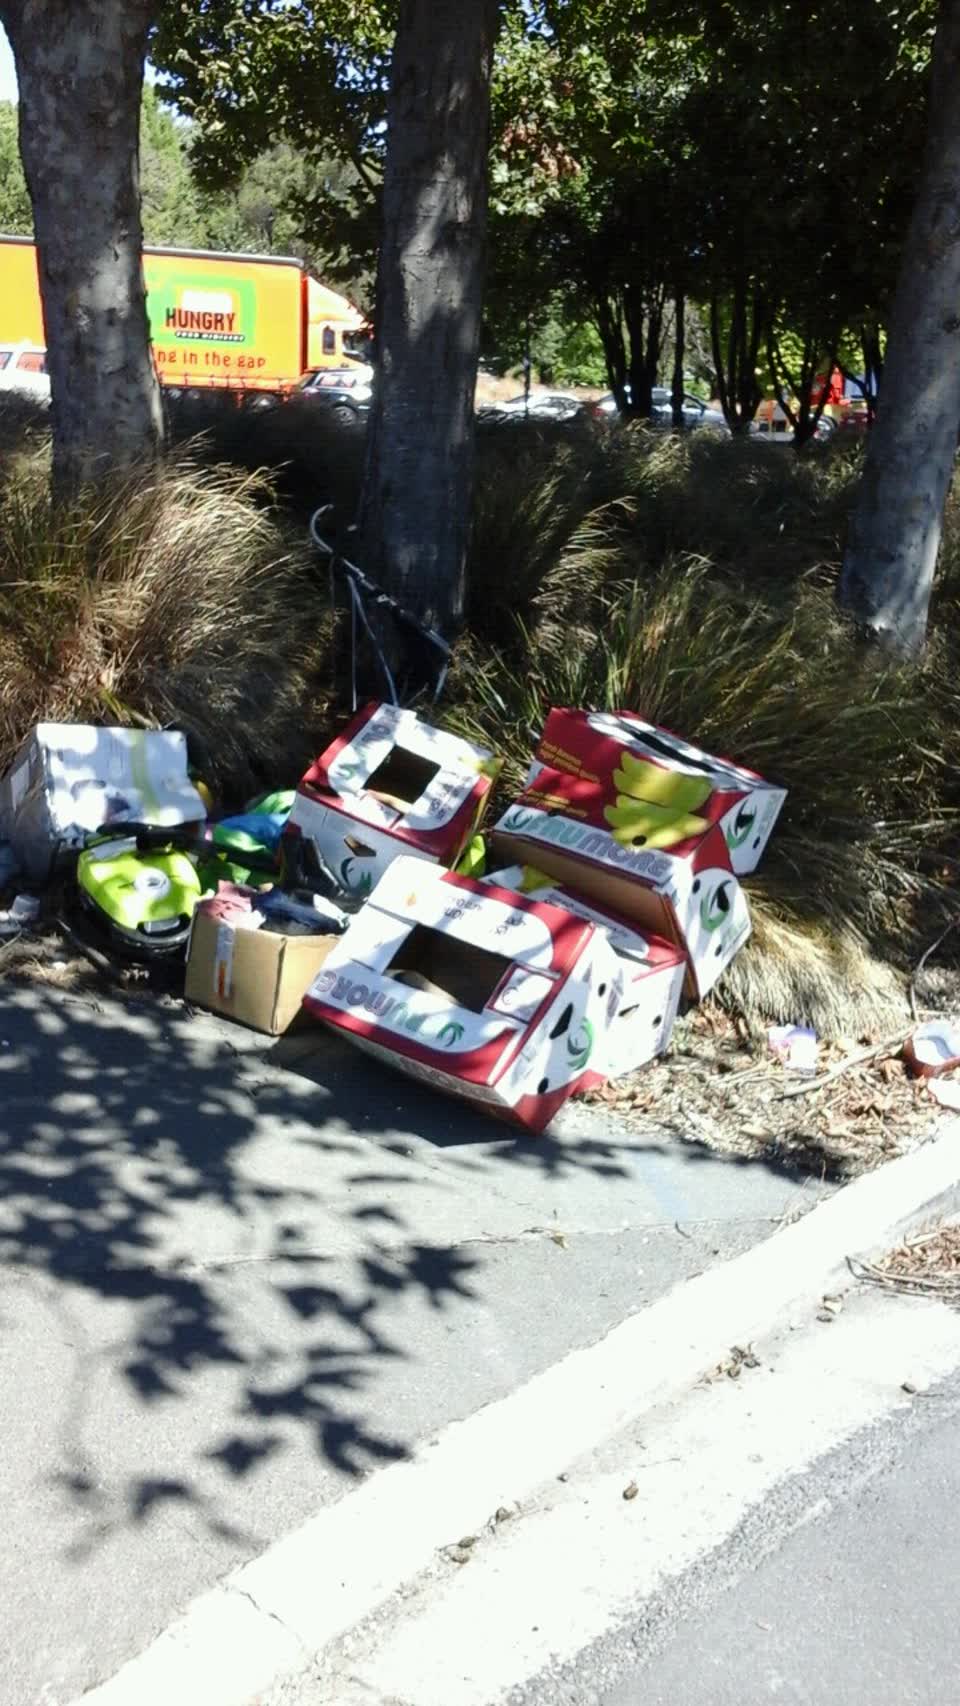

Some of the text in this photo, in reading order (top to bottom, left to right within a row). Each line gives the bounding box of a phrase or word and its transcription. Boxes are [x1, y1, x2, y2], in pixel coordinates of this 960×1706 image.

[165, 307, 236, 332] HUNGRY
[183, 351, 198, 365] in
[204, 352, 231, 367] the
[237, 355, 267, 369] gap
